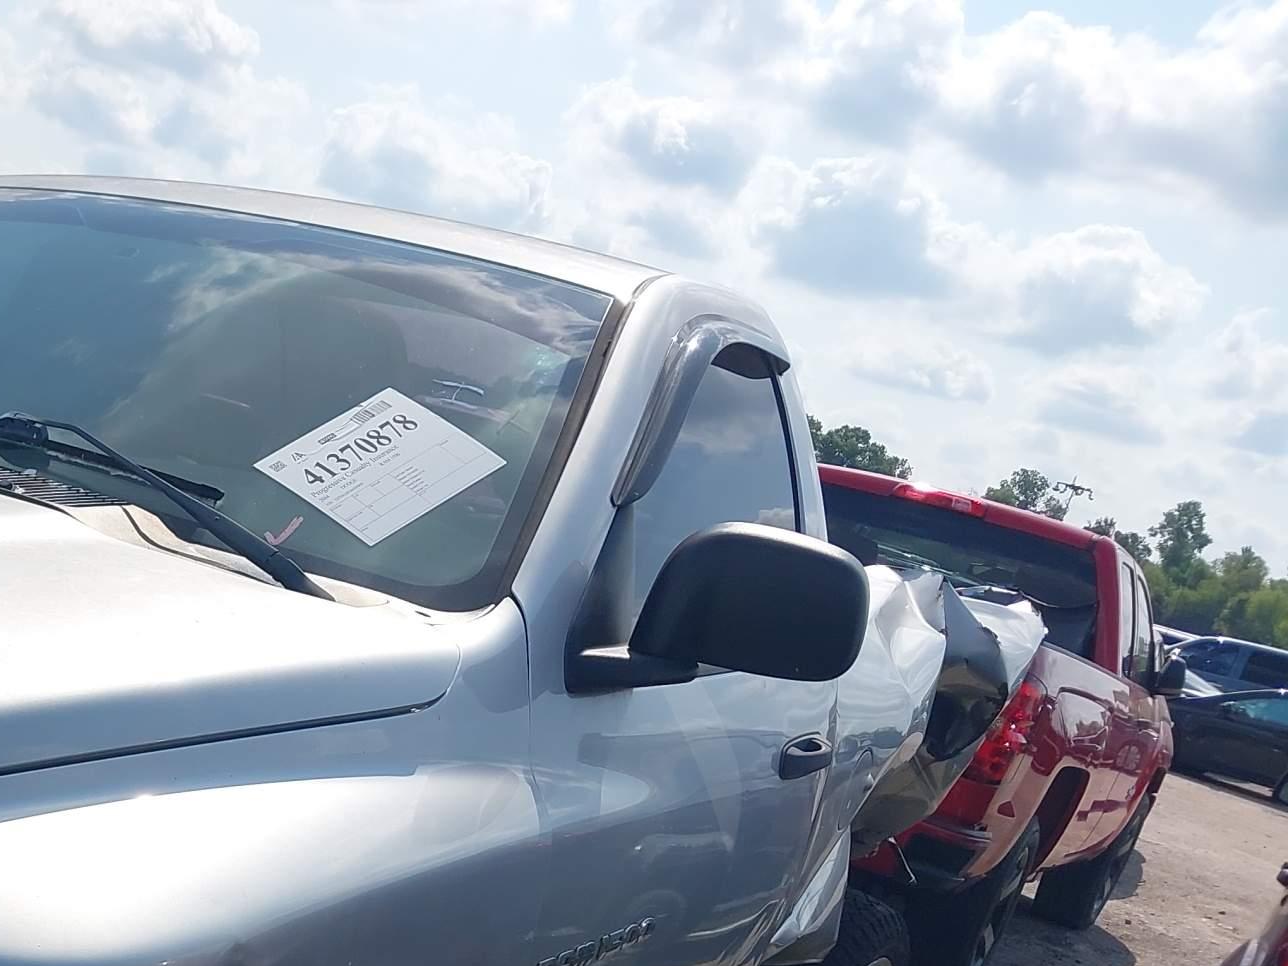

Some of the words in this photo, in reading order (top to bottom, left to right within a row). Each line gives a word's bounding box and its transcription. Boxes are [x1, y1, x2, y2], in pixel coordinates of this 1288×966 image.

[304, 414, 418, 485] 41370878
[311, 476, 347, 498] Progressive
[345, 461, 372, 478] Casualty
[595, 916, 656, 962] 1500
